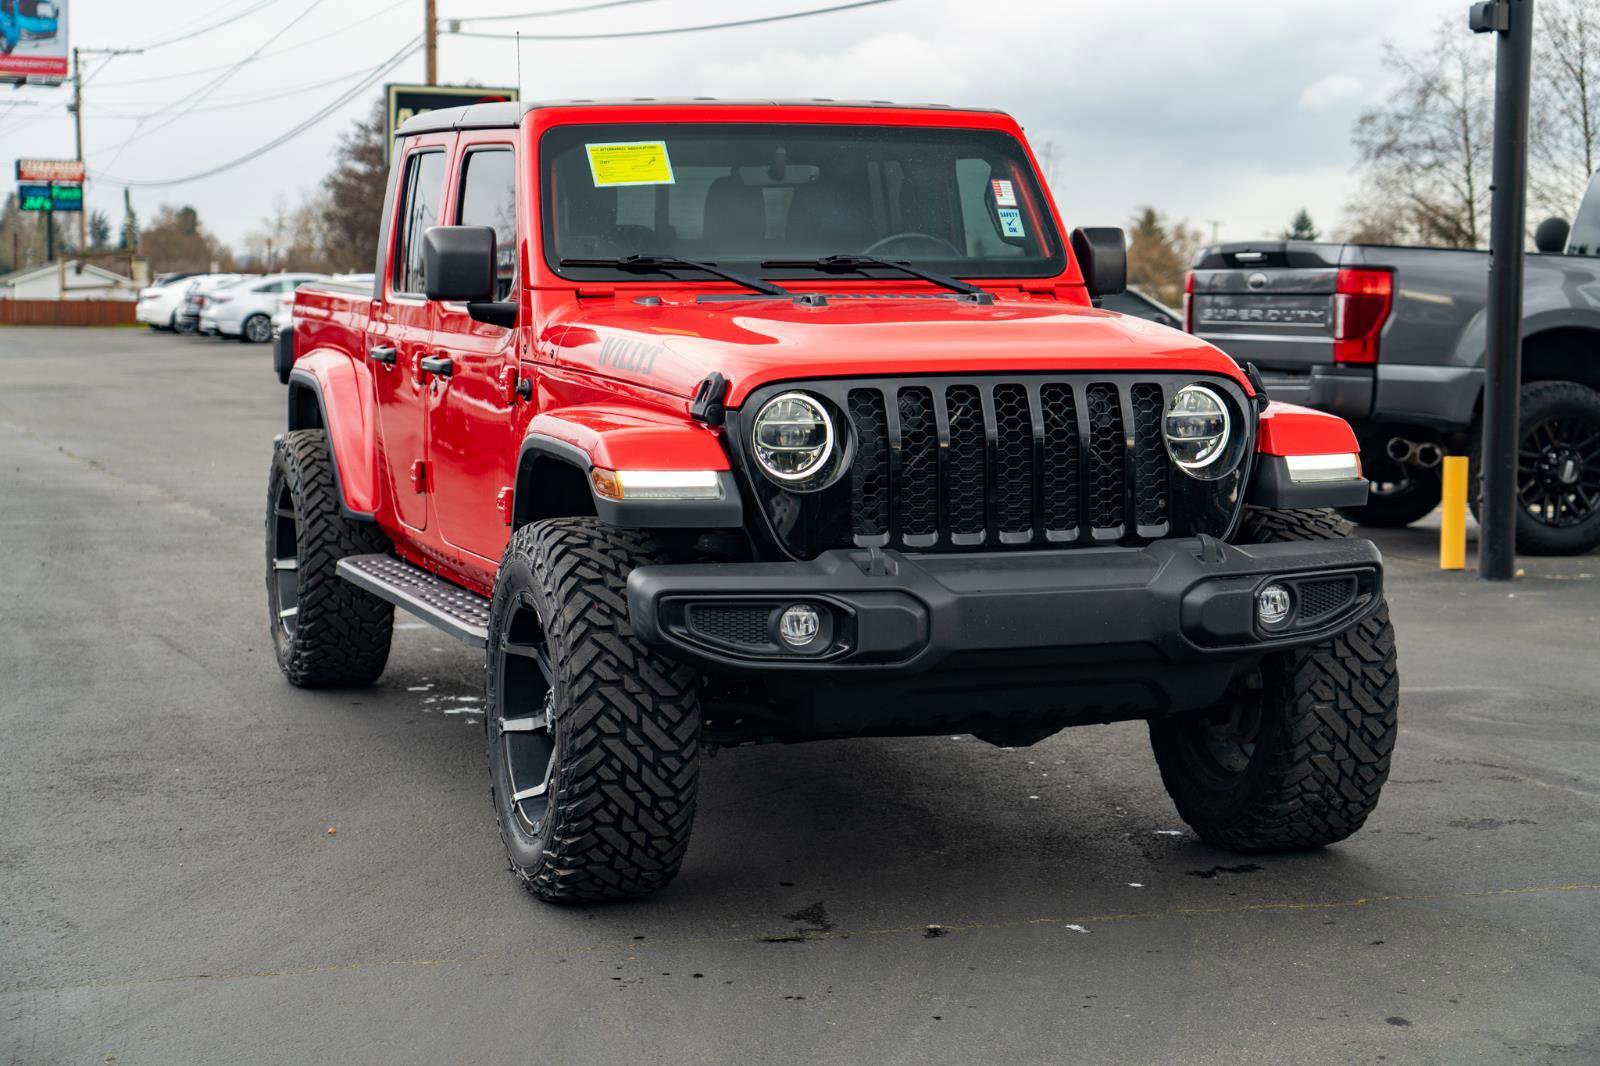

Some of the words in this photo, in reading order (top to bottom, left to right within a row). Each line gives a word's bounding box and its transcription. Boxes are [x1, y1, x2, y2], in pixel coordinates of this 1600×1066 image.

[1202, 308, 1264, 321] SUPER
[1266, 309, 1325, 322] DUTY
[599, 335, 665, 374] WILLYS
